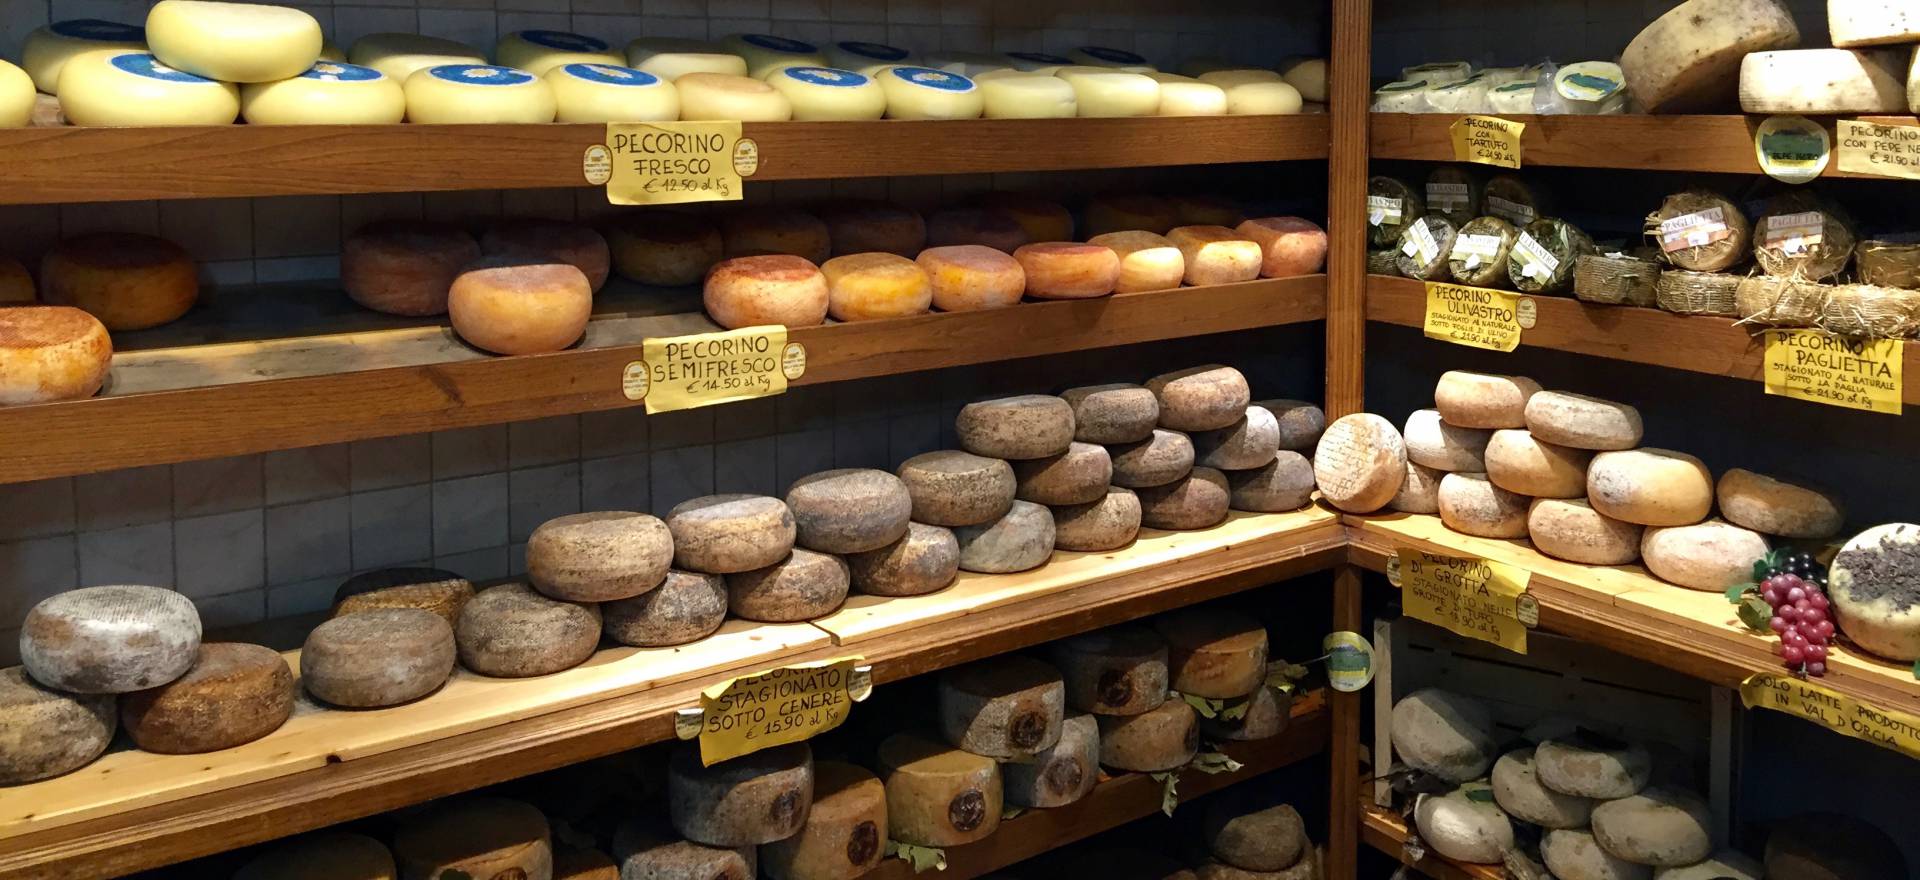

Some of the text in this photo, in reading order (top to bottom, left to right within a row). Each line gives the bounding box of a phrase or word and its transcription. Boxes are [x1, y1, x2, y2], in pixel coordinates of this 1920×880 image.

[1464, 118, 1508, 132] PECORINO
[1850, 125, 1918, 141] PECORINO
[613, 133, 725, 154] PECORINO
[1465, 138, 1508, 151] TARTUFO
[1843, 138, 1867, 149] CON
[1874, 140, 1901, 153] PEPE
[633, 158, 711, 175] FRESCO
[1870, 152, 1879, 163] €
[642, 177, 730, 197] € 12.50 al Kg
[1435, 285, 1492, 304] PECORINO
[1447, 300, 1512, 322] ULIVASTRO
[1430, 319, 1449, 328] SOTTO
[1452, 322, 1474, 332] FOGLIE
[1431, 312, 1469, 324] STAGIONATO
[1482, 321, 1516, 332] NATURALE
[665, 335, 769, 362] PECORINO
[1777, 331, 1864, 356] PECORINO
[653, 357, 776, 382] SEMIFRESCO
[1795, 349, 1892, 378] PAGLIETTA
[686, 374, 771, 394] € 14.50 al Kg
[1772, 362, 1895, 391] STAGIONATO AL NATURALE
[1787, 373, 1867, 394] SOTTO LA PAGLIA
[1410, 559, 1423, 574] DI
[1434, 567, 1490, 597] GROTTA
[1412, 586, 1447, 607] GROTTE
[1464, 607, 1494, 624] TUFO
[1413, 576, 1477, 608] STAGIONATO
[1483, 602, 1512, 618] NELLE
[717, 668, 841, 712] STAGIONATO
[1752, 675, 1791, 692] SOLO
[1799, 686, 1842, 710] LATTE
[708, 707, 766, 733] SOTTO
[779, 689, 843, 717] CENERE
[1775, 693, 1789, 706] IN
[1801, 702, 1829, 722] VAL
[745, 726, 758, 740] €
[809, 711, 822, 727] al
